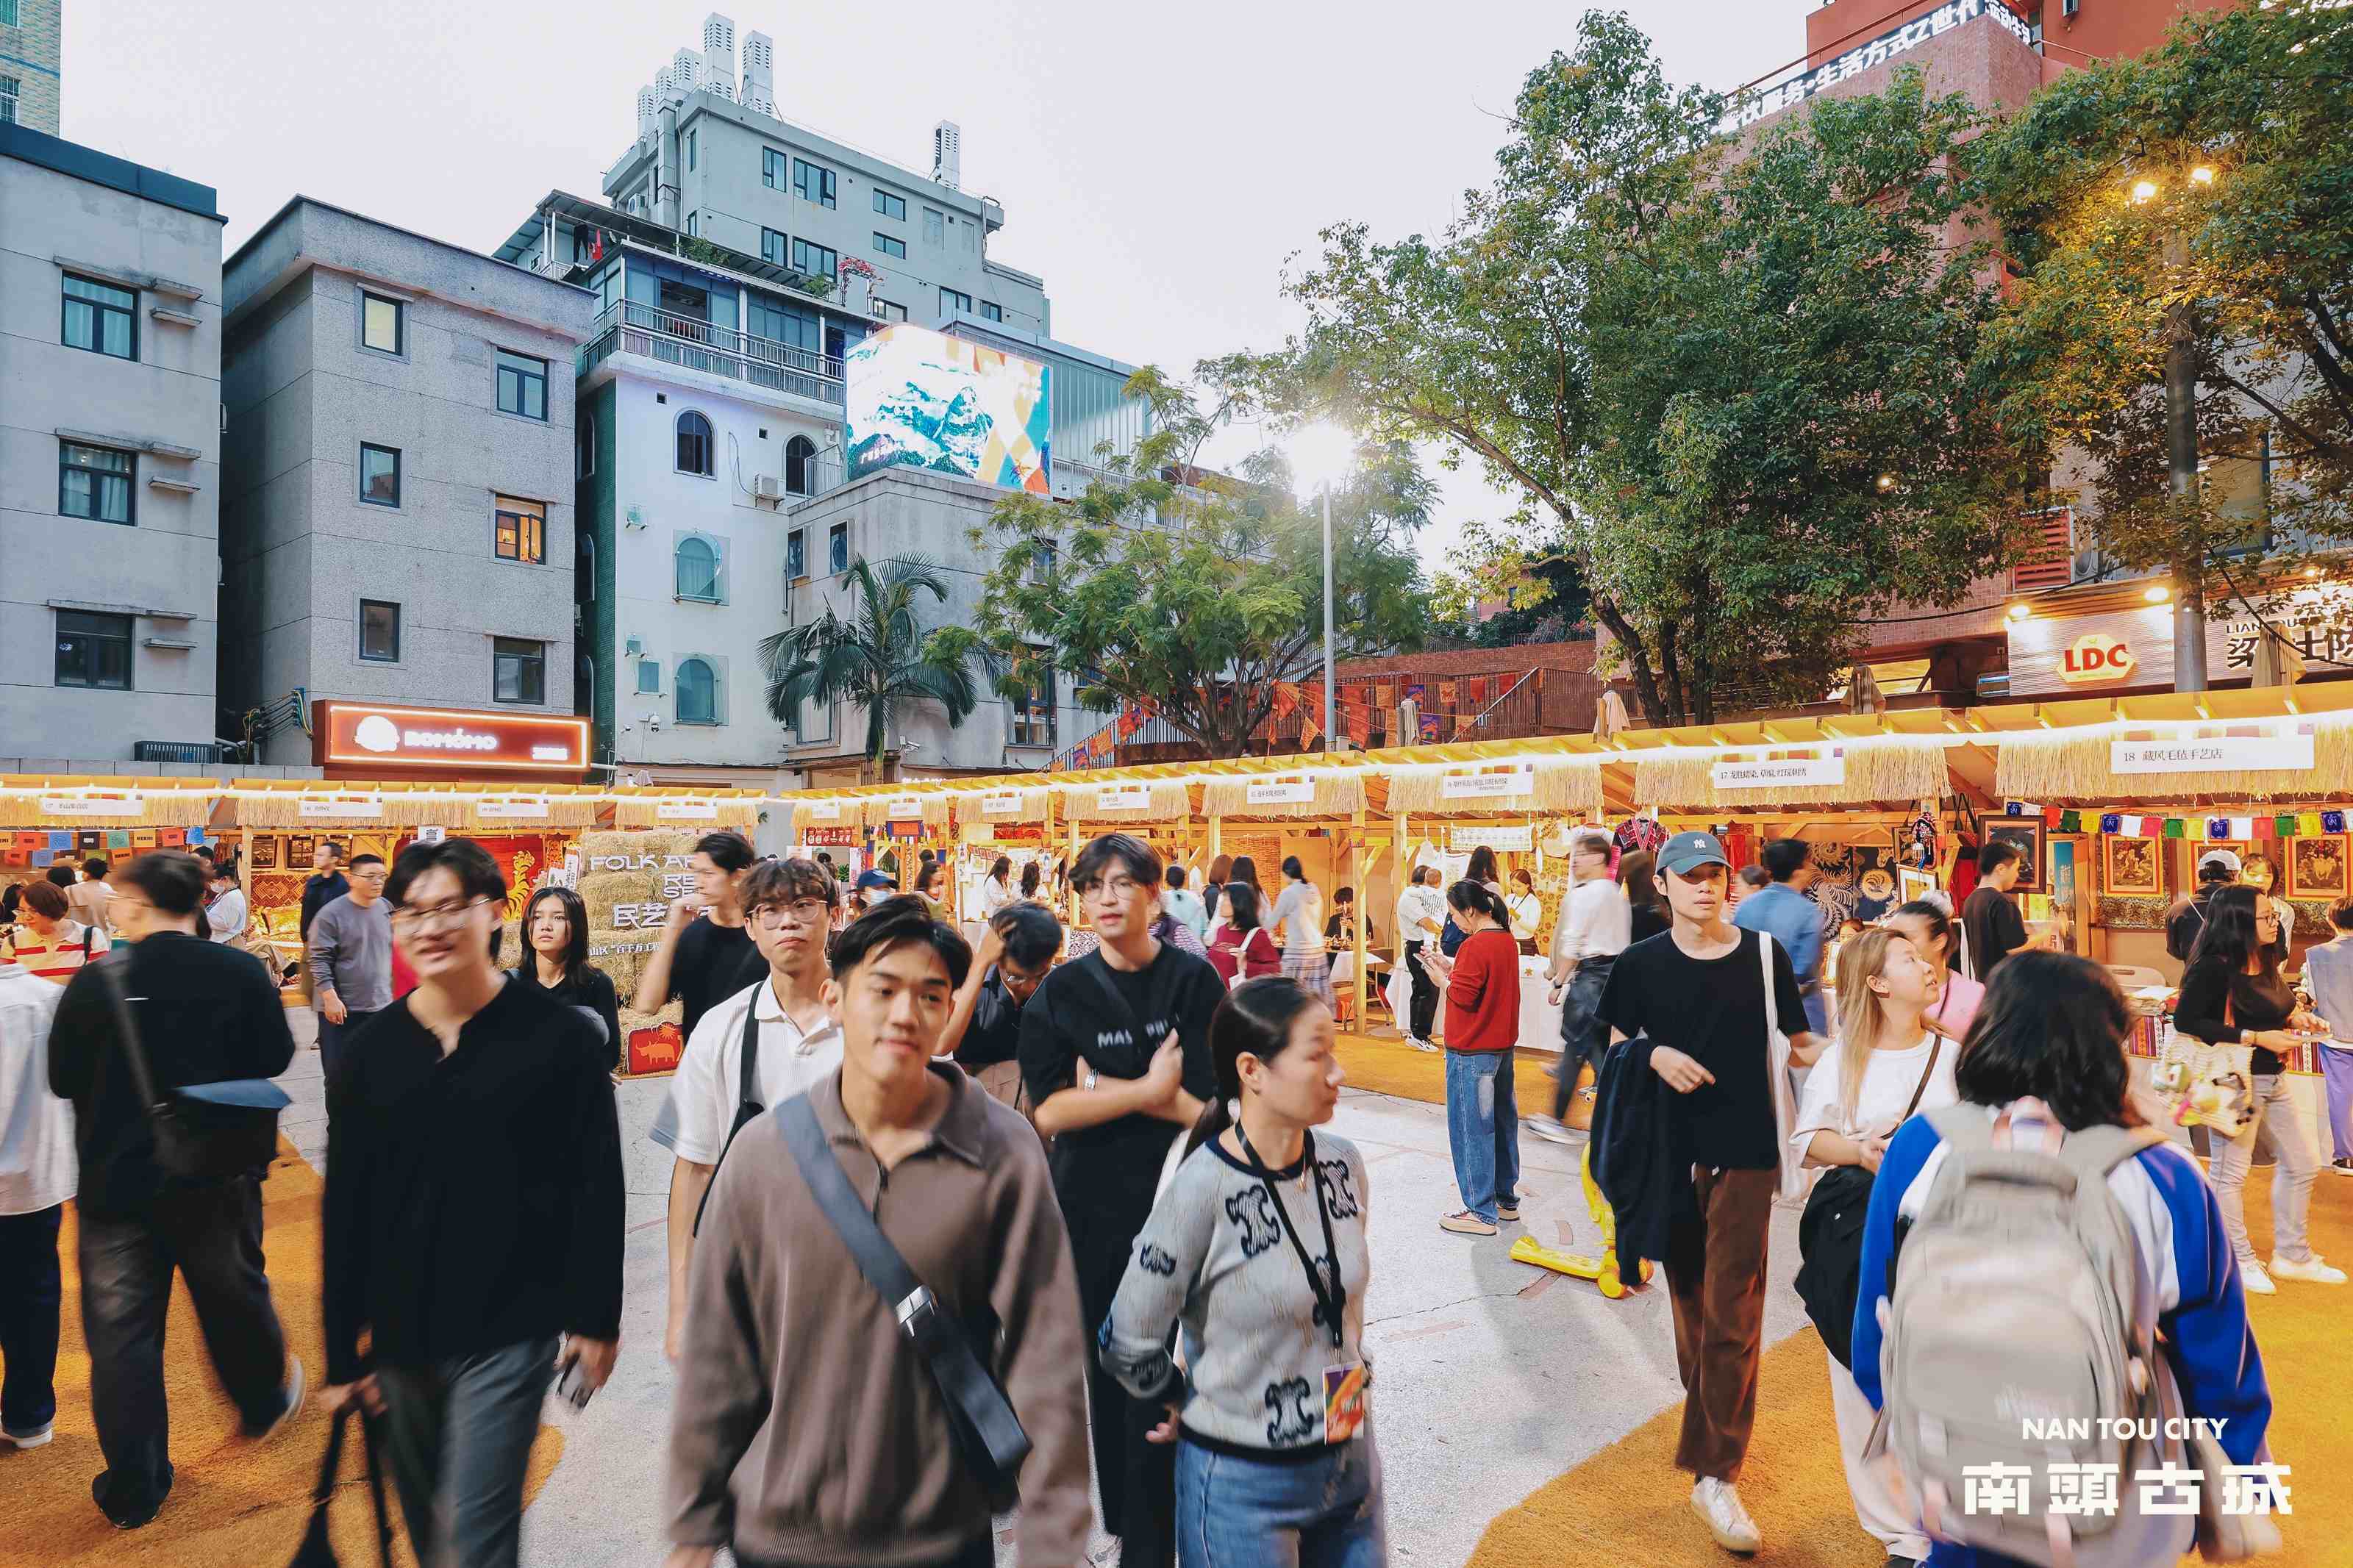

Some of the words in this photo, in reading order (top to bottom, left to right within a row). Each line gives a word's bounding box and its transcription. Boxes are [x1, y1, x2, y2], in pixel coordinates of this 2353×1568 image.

[2065, 644, 2129, 672] LDC
[2124, 752, 2135, 762] 18
[590, 854, 660, 870] FOLK
